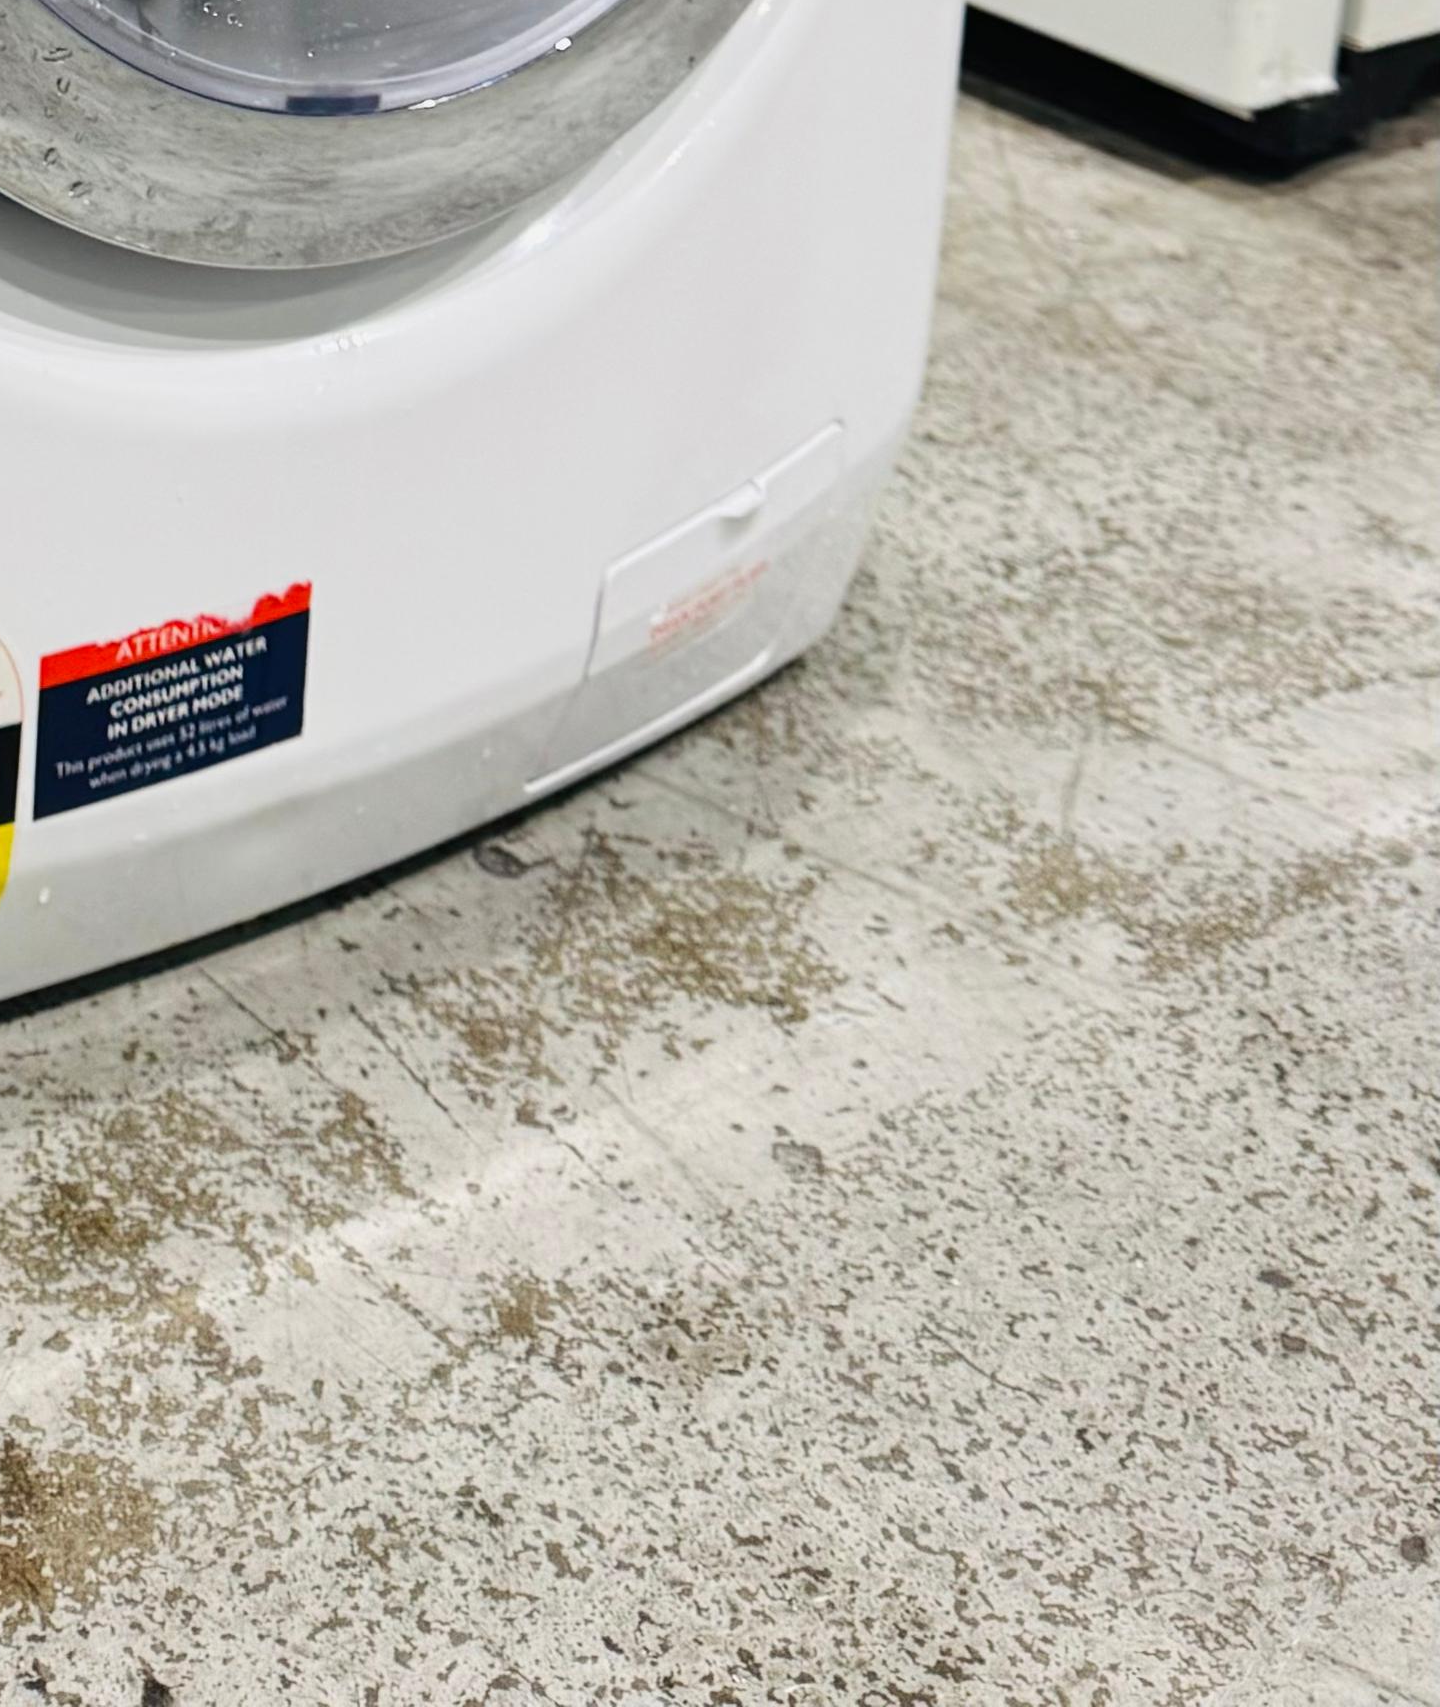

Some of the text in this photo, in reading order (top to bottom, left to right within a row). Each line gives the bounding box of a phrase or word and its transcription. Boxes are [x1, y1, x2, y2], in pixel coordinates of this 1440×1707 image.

[86, 635, 268, 705] ADDITIONAL WATER
[115, 619, 222, 663] ATTENTI
[107, 684, 244, 741] IN DRYER MODE
[110, 664, 244, 719] CONSUMPTION
[56, 760, 84, 779] This
[88, 742, 143, 772] product
[146, 732, 176, 752] uses
[252, 695, 288, 718] water
[88, 771, 127, 789] when
[130, 756, 172, 780] drying
[228, 724, 257, 746] load
